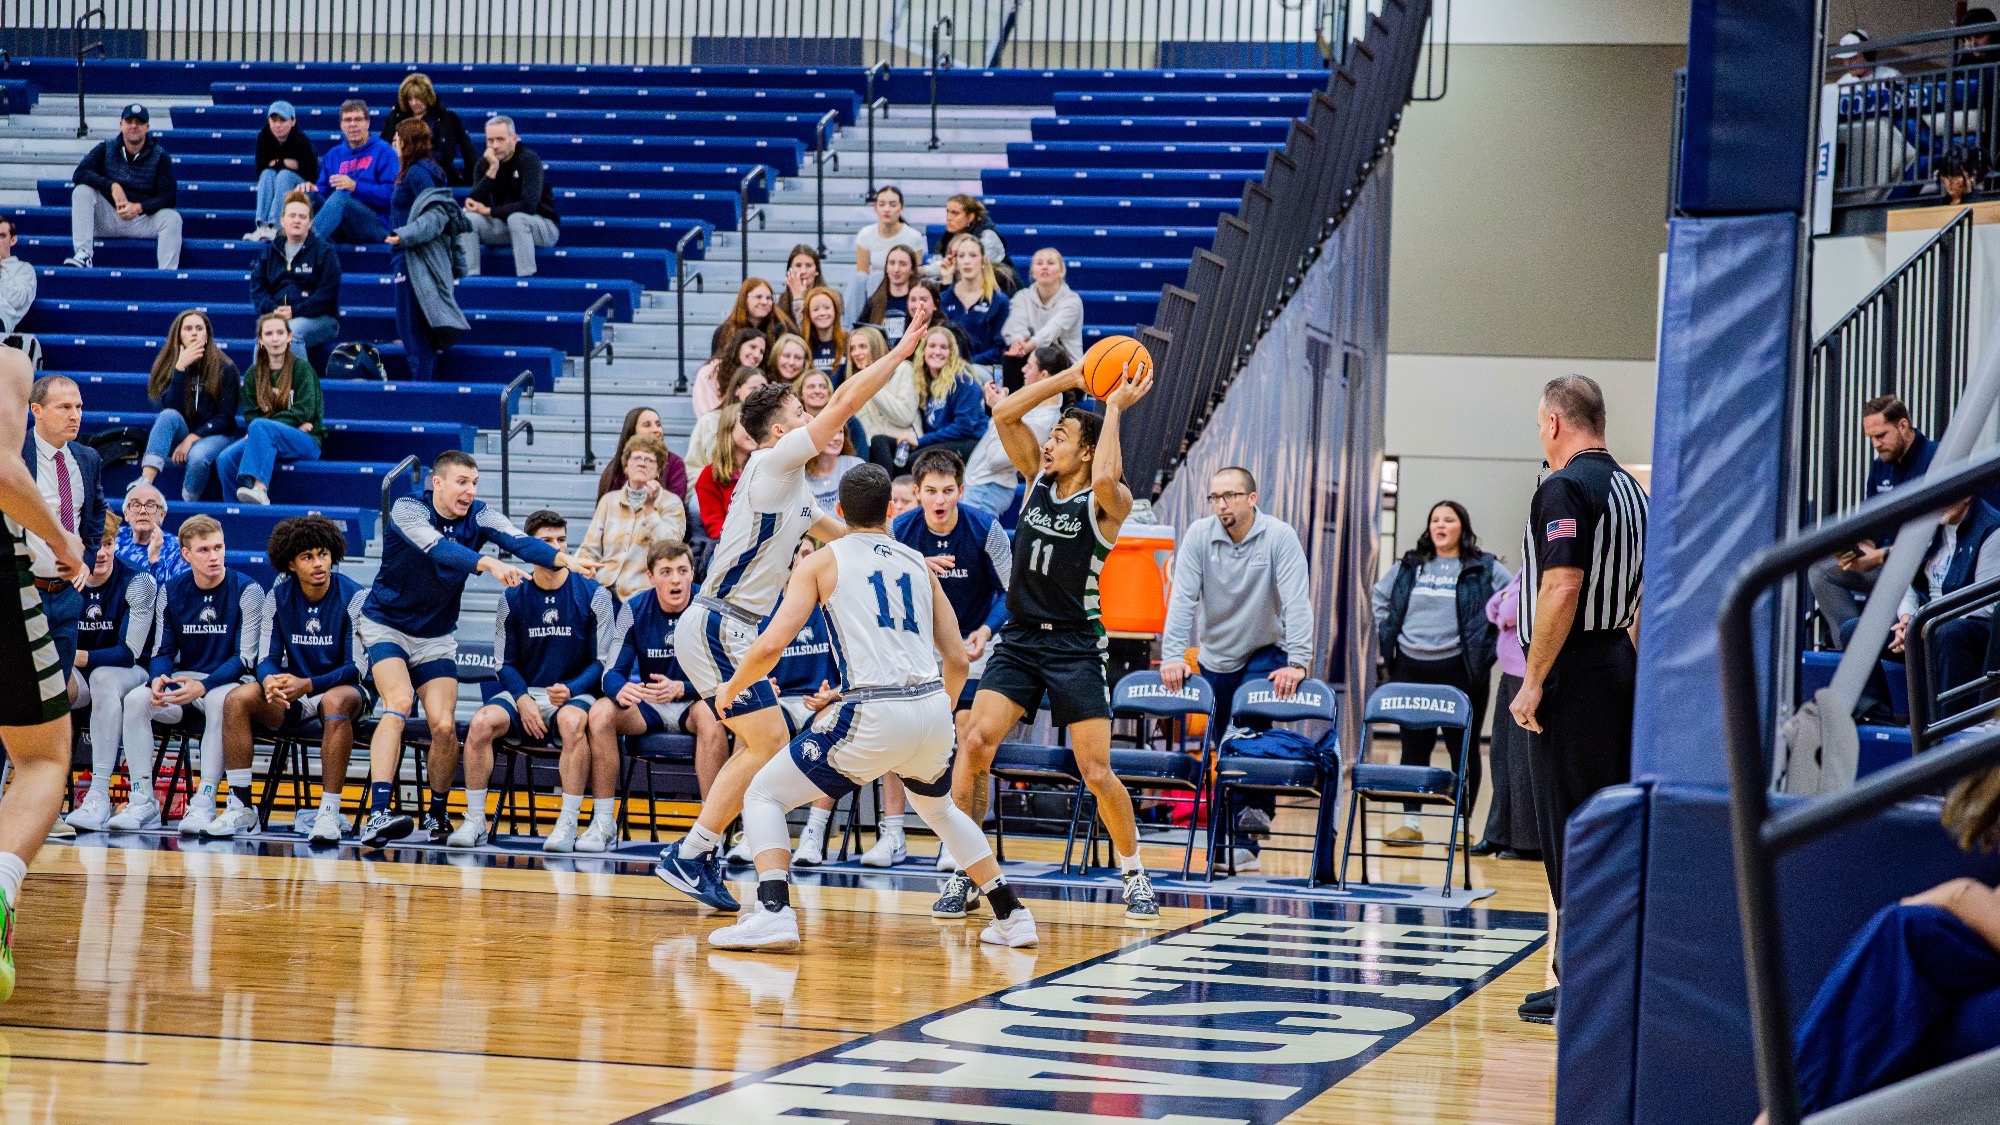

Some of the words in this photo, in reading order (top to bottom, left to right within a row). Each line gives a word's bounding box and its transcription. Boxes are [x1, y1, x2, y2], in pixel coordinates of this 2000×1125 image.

[1053, 513, 1082, 533] Erie
[1029, 538, 1054, 576] 11
[867, 569, 920, 635] 11
[77, 620, 114, 631] ILLSDALE
[182, 624, 227, 634] HILLSDALE
[528, 626, 571, 638] HILLSDALE
[291, 634, 333, 645] HILLSDALE
[781, 642, 829, 658] HILLSDALE
[1248, 690, 1322, 706] HILLDALE
[1380, 696, 1456, 714] HILLSDALE
